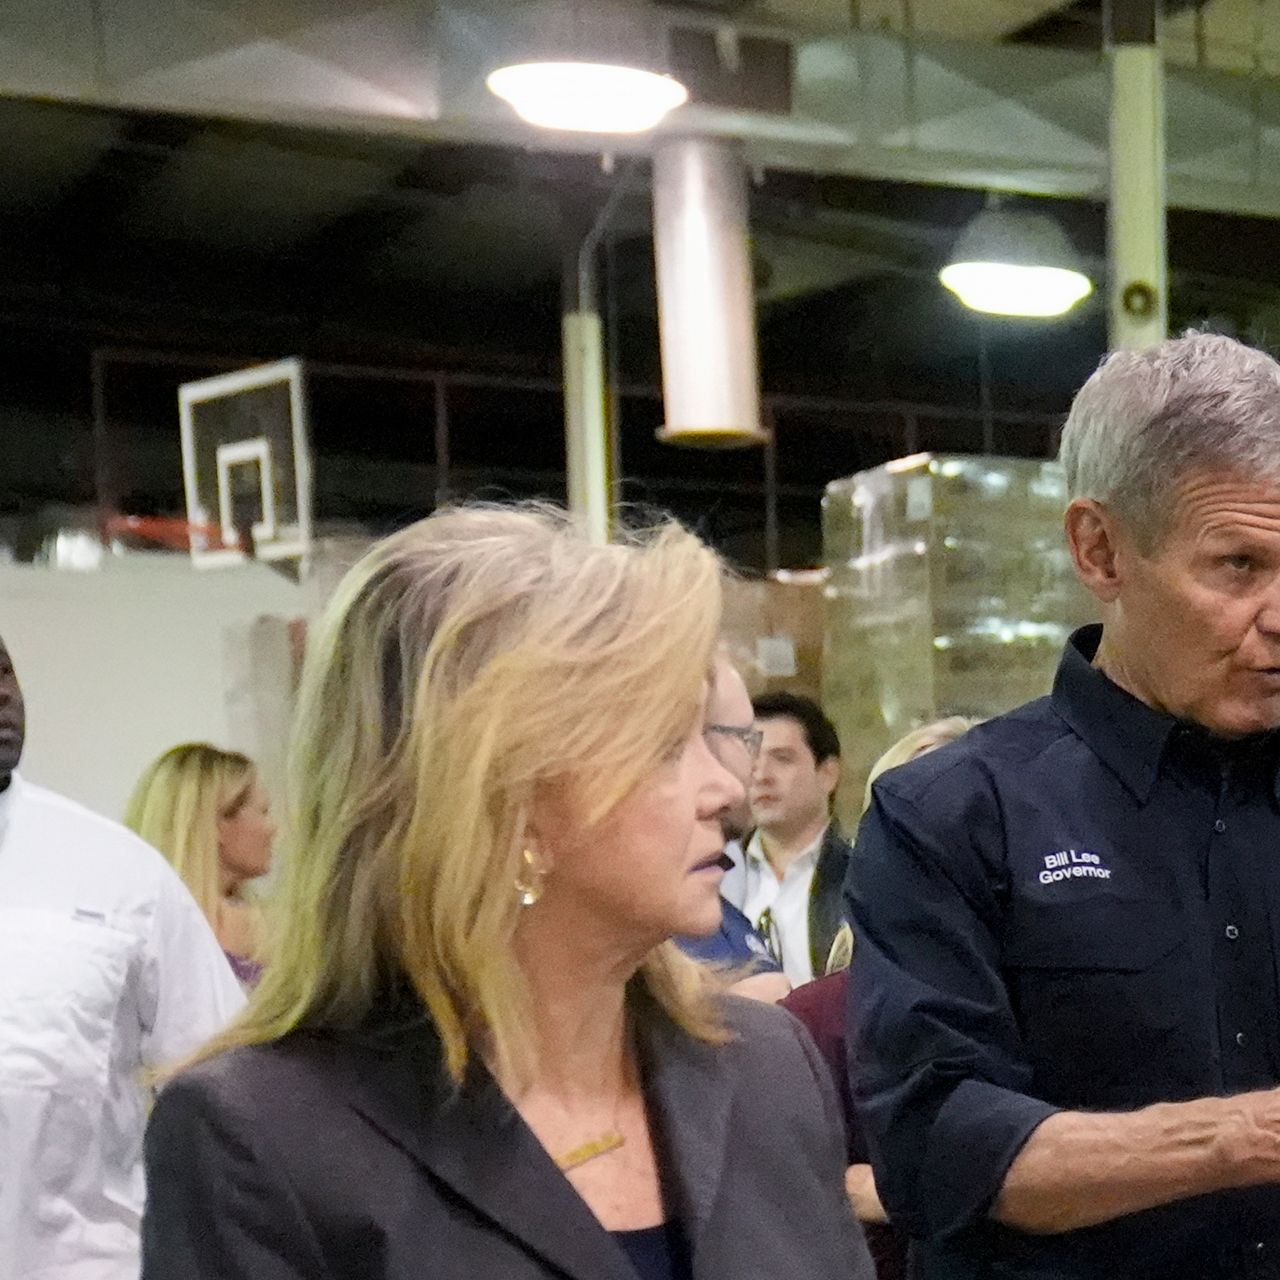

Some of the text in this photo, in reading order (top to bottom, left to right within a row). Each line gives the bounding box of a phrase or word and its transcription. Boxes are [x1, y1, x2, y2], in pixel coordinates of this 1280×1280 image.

[1044, 849, 1100, 869] Bill Lee
[1039, 865, 1111, 884] Governor
